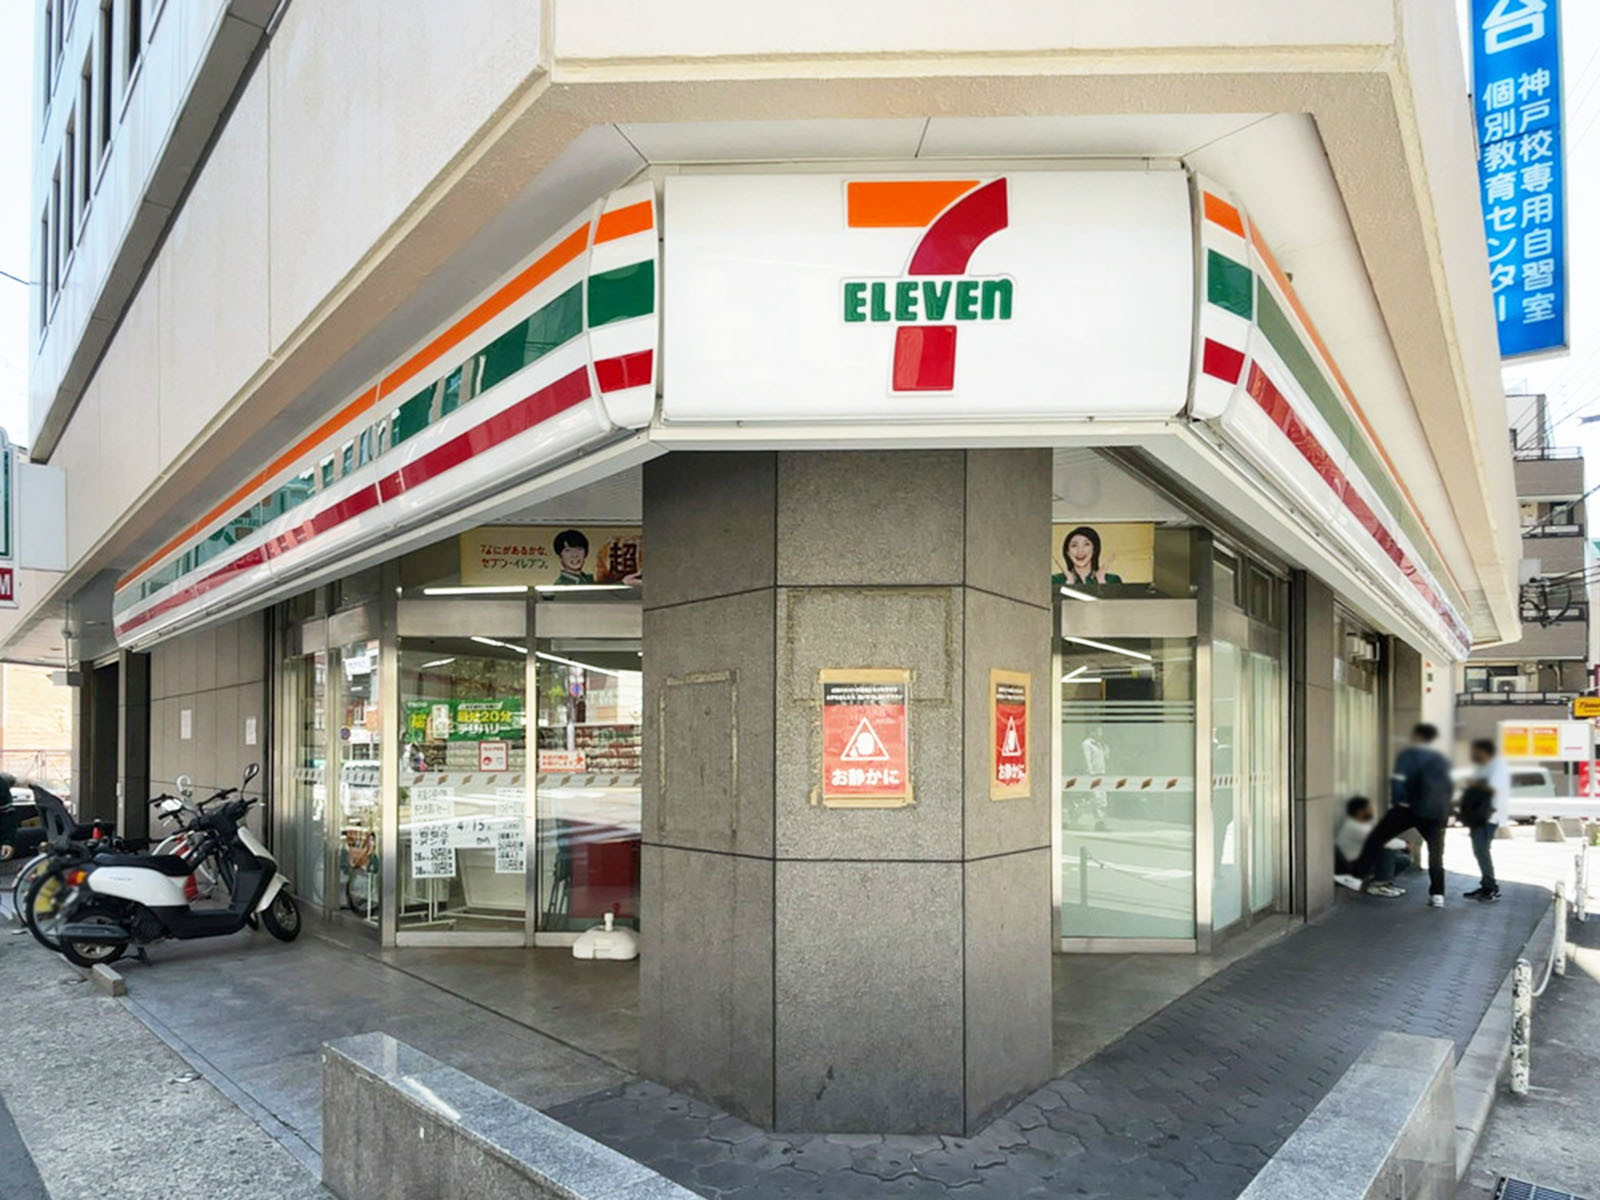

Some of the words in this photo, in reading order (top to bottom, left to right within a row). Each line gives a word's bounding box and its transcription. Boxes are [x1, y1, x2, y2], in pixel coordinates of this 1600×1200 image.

[847, 177, 1008, 391] 7
[1483, 78, 1517, 321] 個別教育センター
[1518, 68, 1554, 324] 神戸校専用自習室
[609, 541, 638, 575] 超
[832, 769, 899, 786] お静かに
